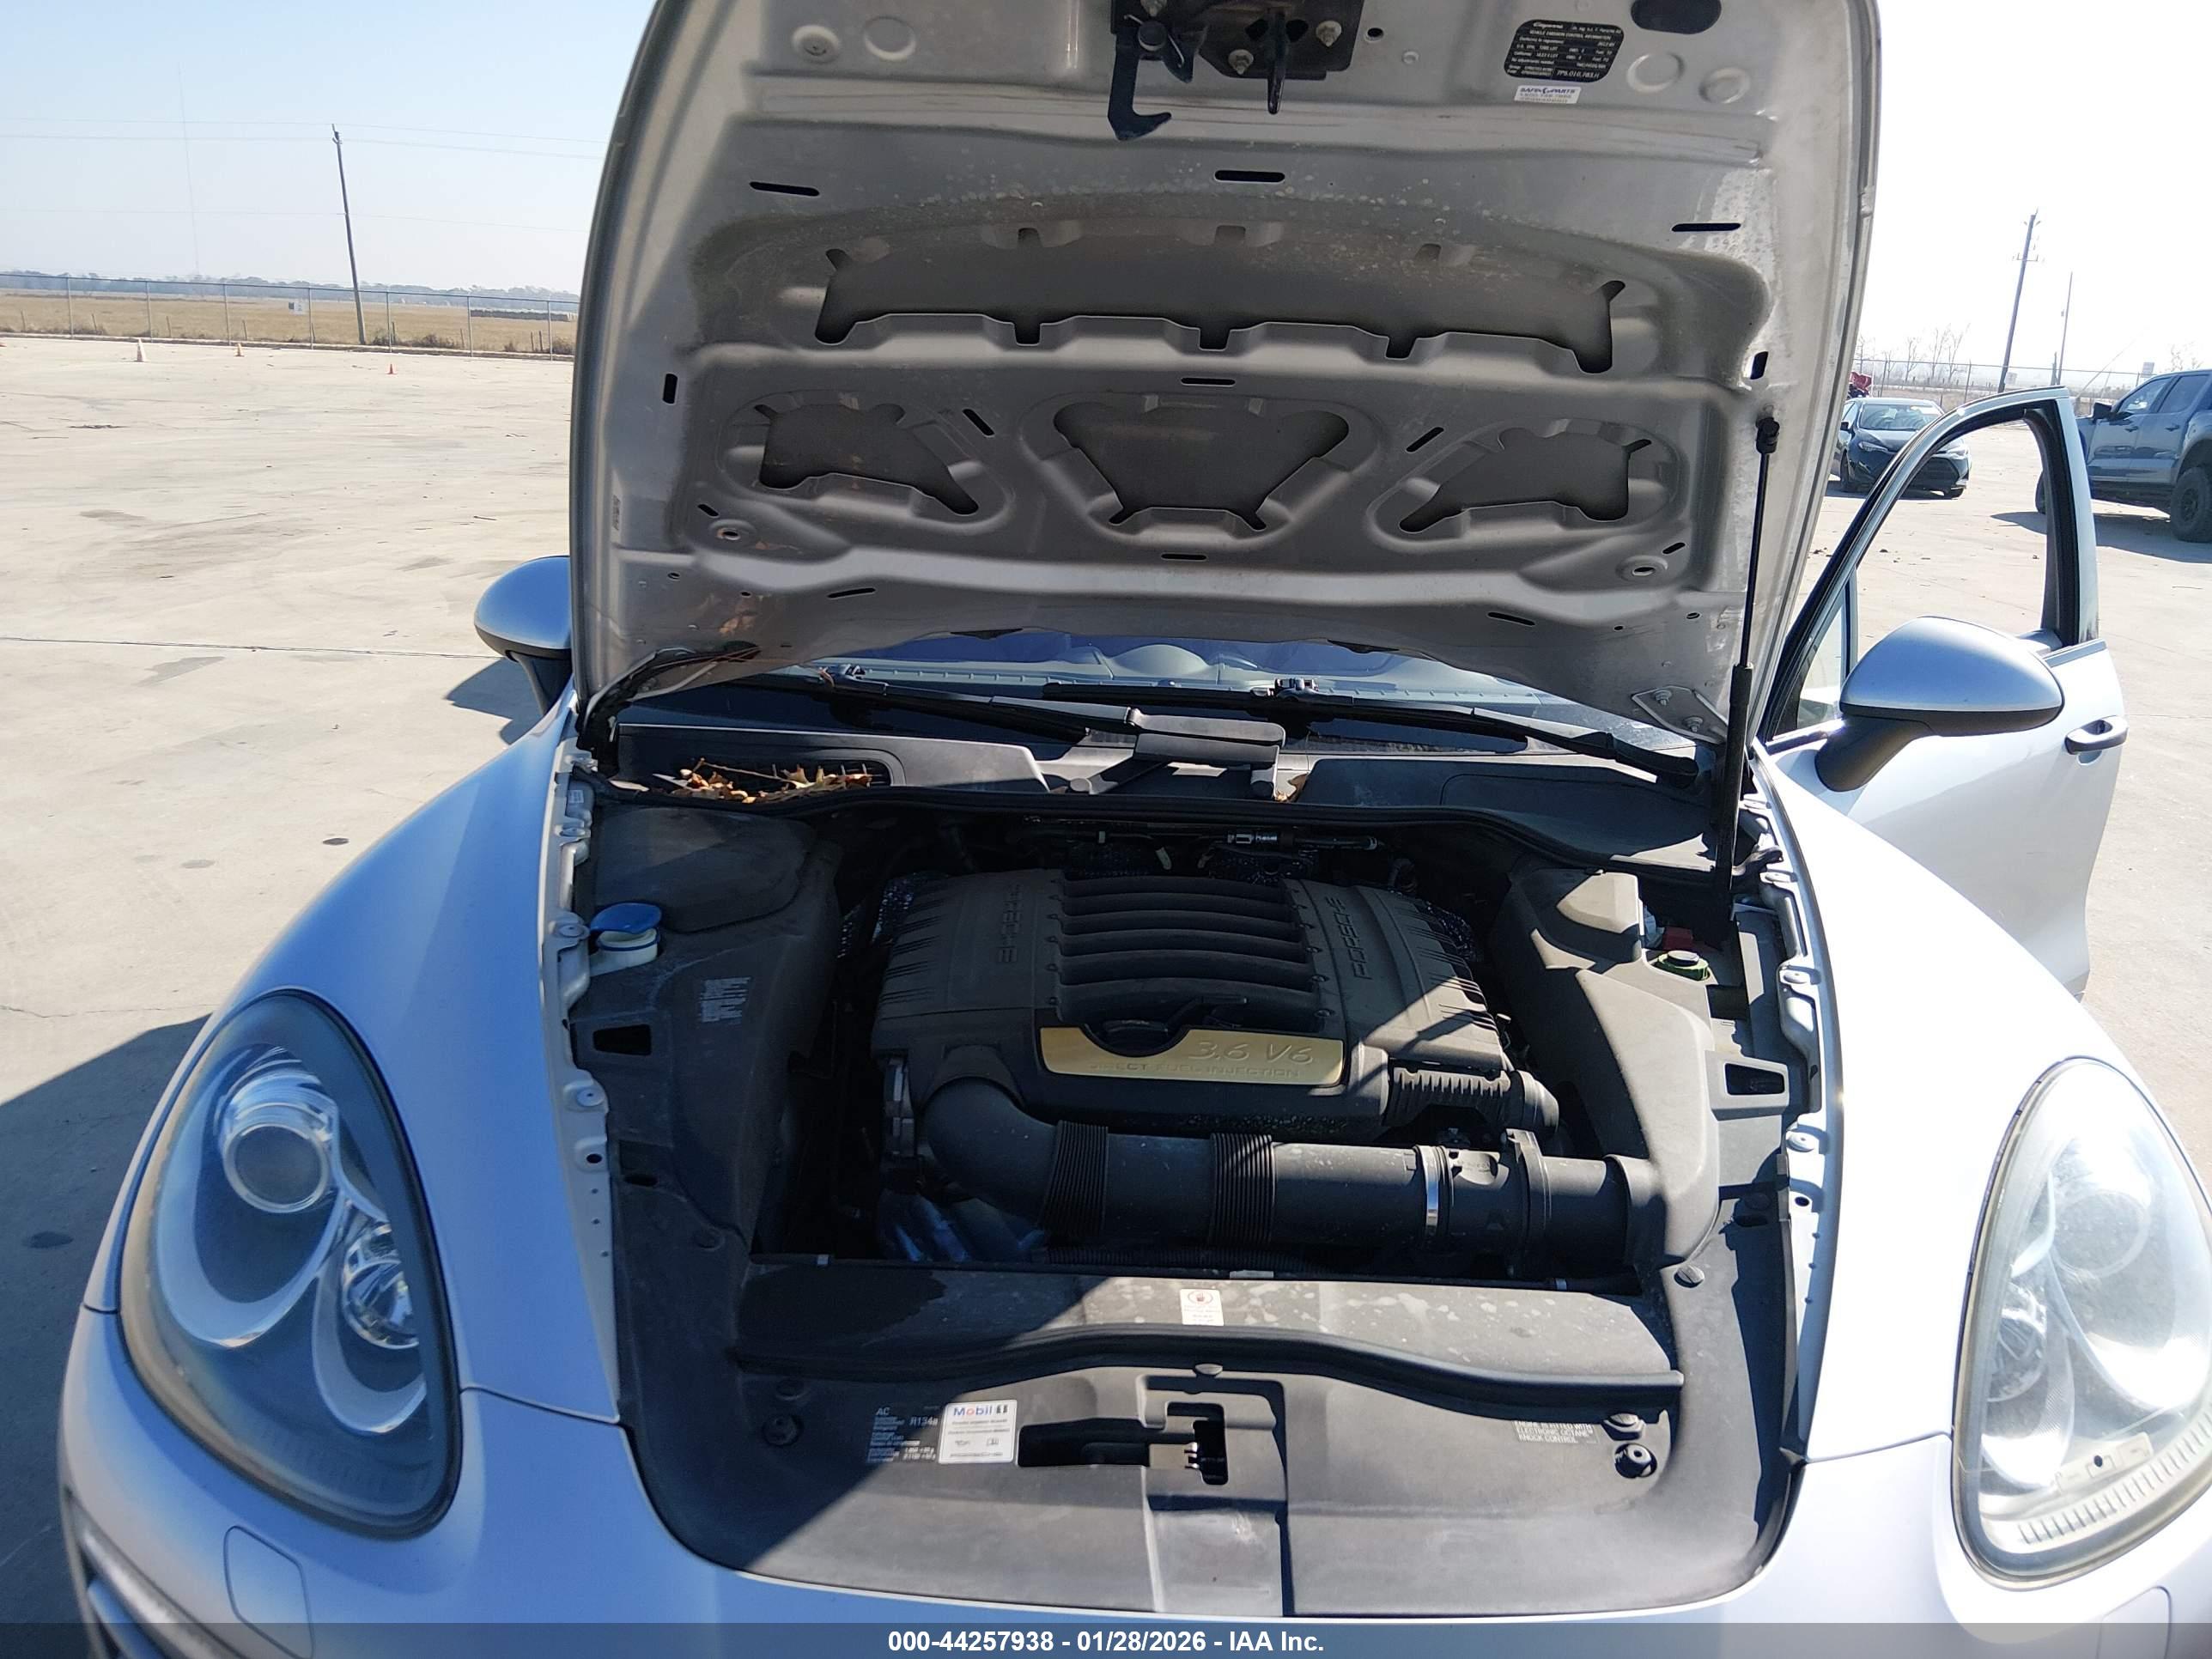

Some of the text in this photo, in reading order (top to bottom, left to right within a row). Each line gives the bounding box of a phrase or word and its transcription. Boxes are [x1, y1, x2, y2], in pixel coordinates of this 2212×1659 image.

[1325, 896, 1372, 981] PORSCHE
[1188, 1042, 1314, 1064] 3.6 V6
[1155, 1063, 1195, 1073] FUEL
[1209, 1066, 1302, 1079] INJECTION
[876, 1407, 890, 1416] AC
[953, 1405, 993, 1416] Mobil
